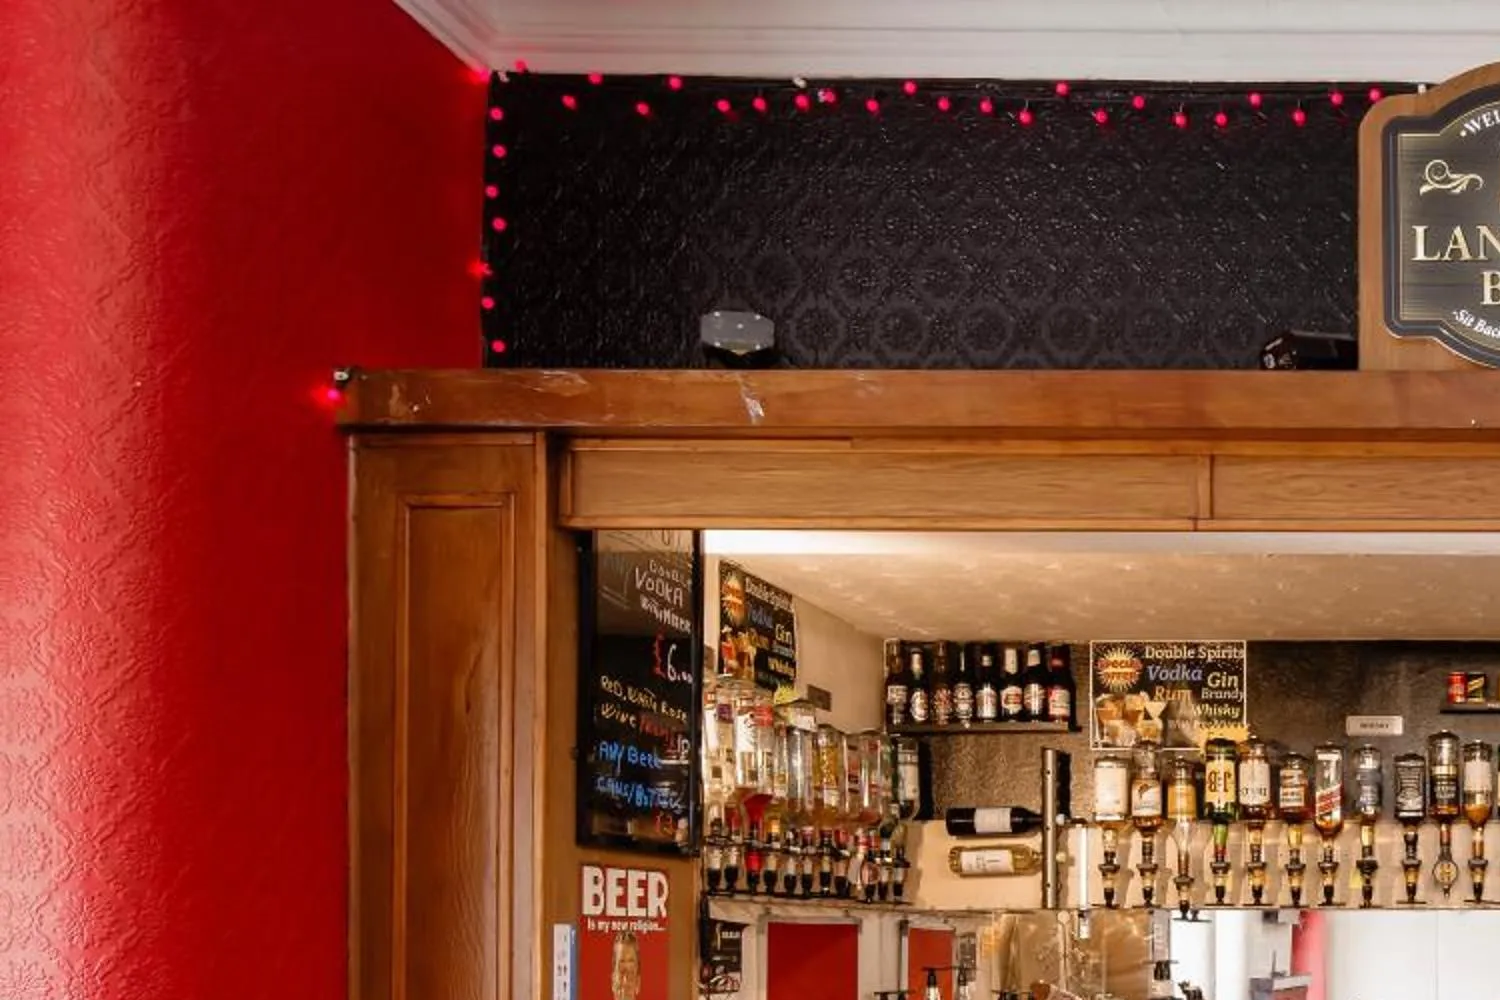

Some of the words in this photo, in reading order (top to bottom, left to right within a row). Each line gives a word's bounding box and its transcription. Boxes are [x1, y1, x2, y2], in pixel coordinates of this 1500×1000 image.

[1145, 645, 1195, 659] Double
[1199, 645, 1244, 662] Spirits
[1147, 663, 1203, 681] Vodka
[1207, 671, 1239, 688] Gin
[1153, 685, 1192, 701] Rum
[582, 865, 669, 918] BEER
